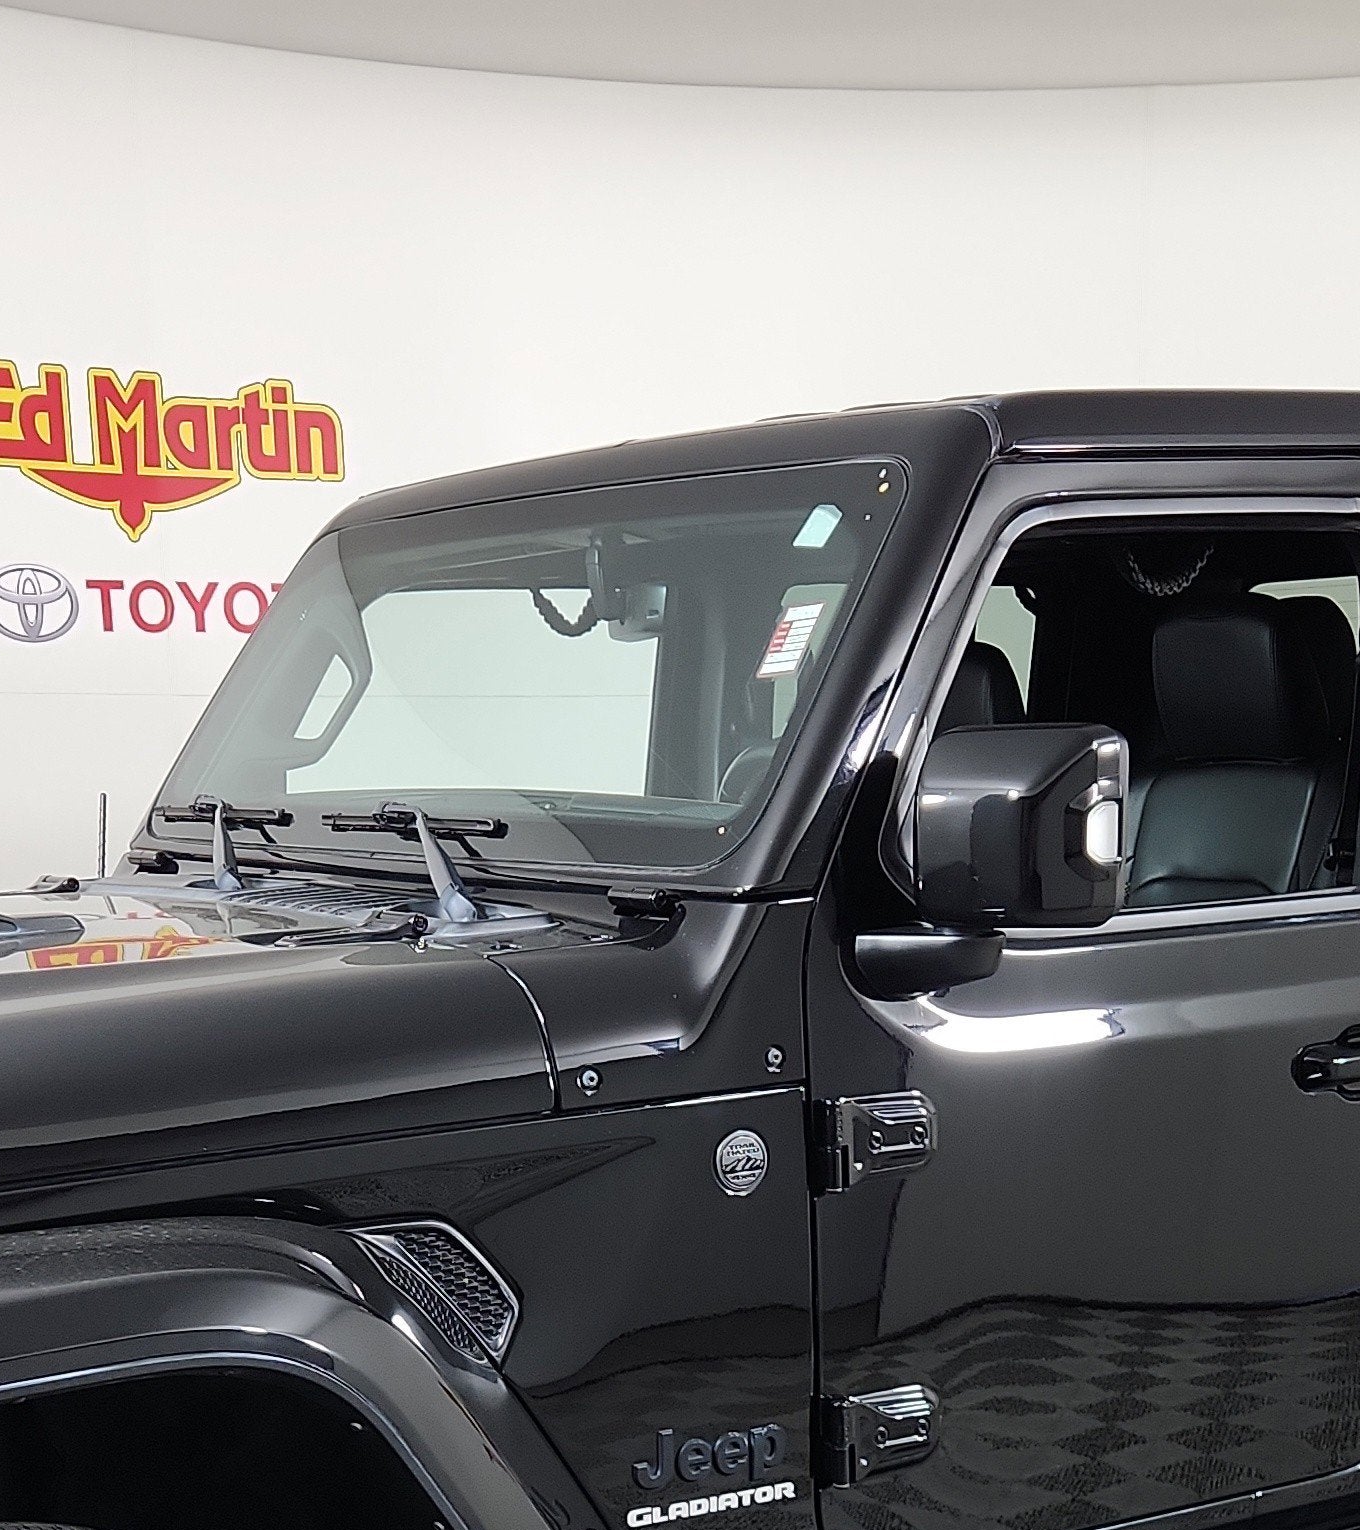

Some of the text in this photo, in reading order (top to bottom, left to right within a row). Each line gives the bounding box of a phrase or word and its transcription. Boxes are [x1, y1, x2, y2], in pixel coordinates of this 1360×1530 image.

[87, 368, 344, 482] Martin
[85, 579, 281, 634] TOYO
[632, 1424, 788, 1489] Jeep
[626, 1481, 796, 1528] GLADIATOR
